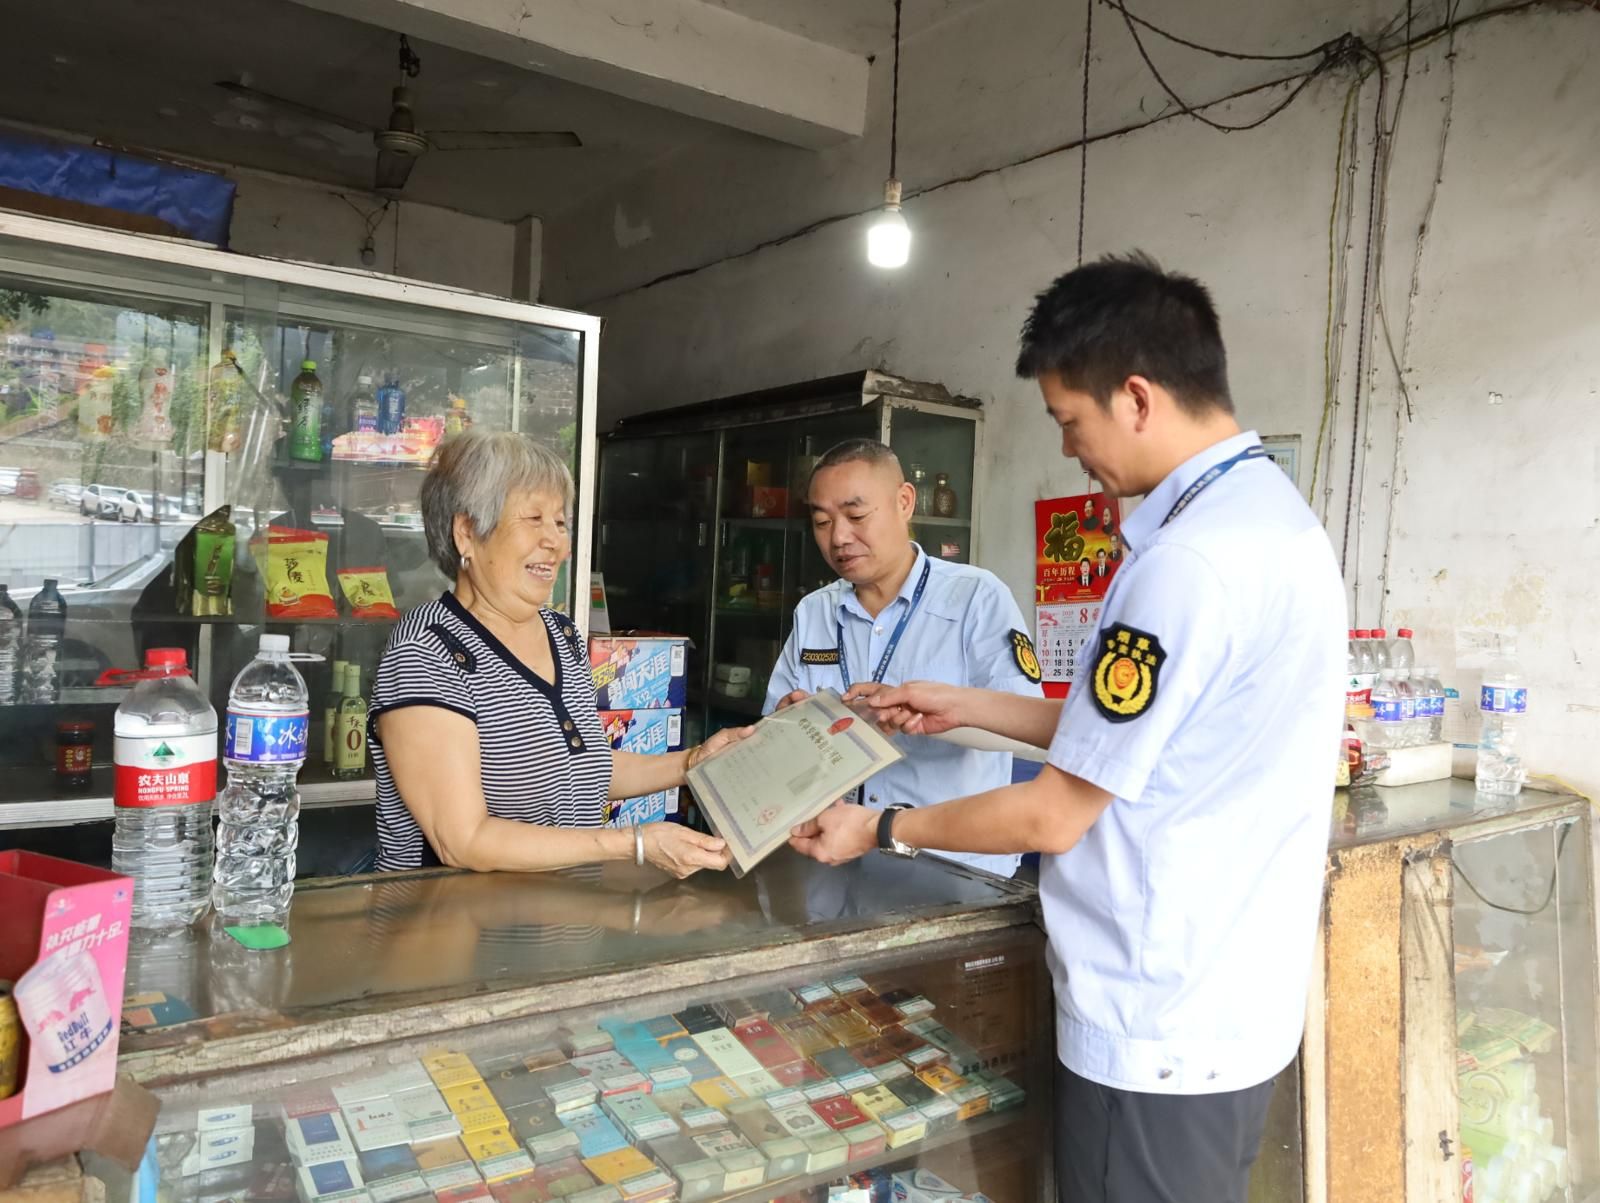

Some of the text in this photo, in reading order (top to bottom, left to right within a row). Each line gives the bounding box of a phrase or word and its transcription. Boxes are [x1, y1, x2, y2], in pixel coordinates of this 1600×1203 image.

[1044, 511, 1085, 562] 福
[1080, 607, 1088, 624] 8
[1056, 639, 1061, 647] 4
[1068, 639, 1073, 647] 5
[1054, 659, 1061, 667] 18
[608, 651, 669, 702] 勇闯天涯
[346, 729, 362, 750] 0
[138, 771, 189, 787] 农夫山泉
[165, 785, 189, 793] SPRING
[57, 1011, 90, 1043] RedBull
